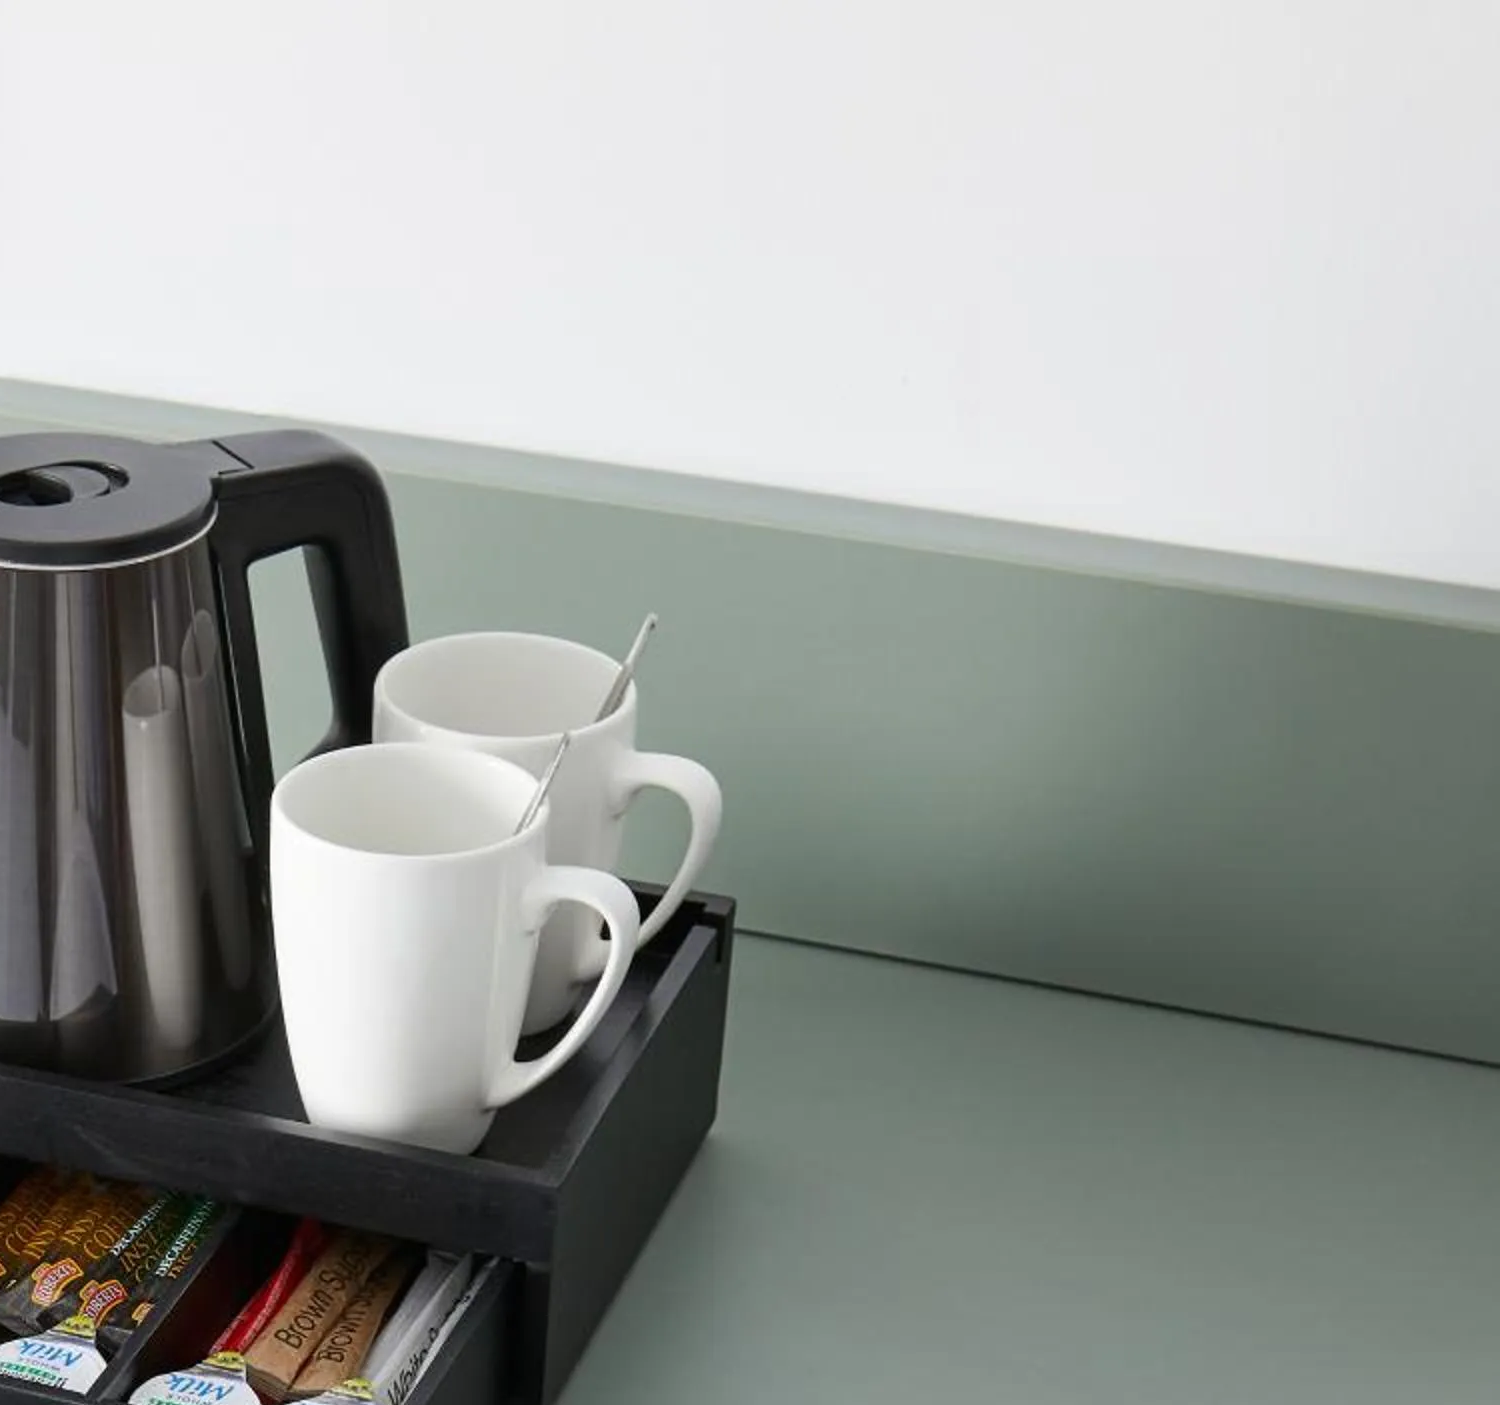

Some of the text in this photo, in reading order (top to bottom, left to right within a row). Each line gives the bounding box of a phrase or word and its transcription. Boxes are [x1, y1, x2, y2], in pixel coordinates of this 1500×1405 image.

[274, 1289, 334, 1350] Brown
[18, 1340, 83, 1367] Milk
[165, 1373, 235, 1401] Milk
